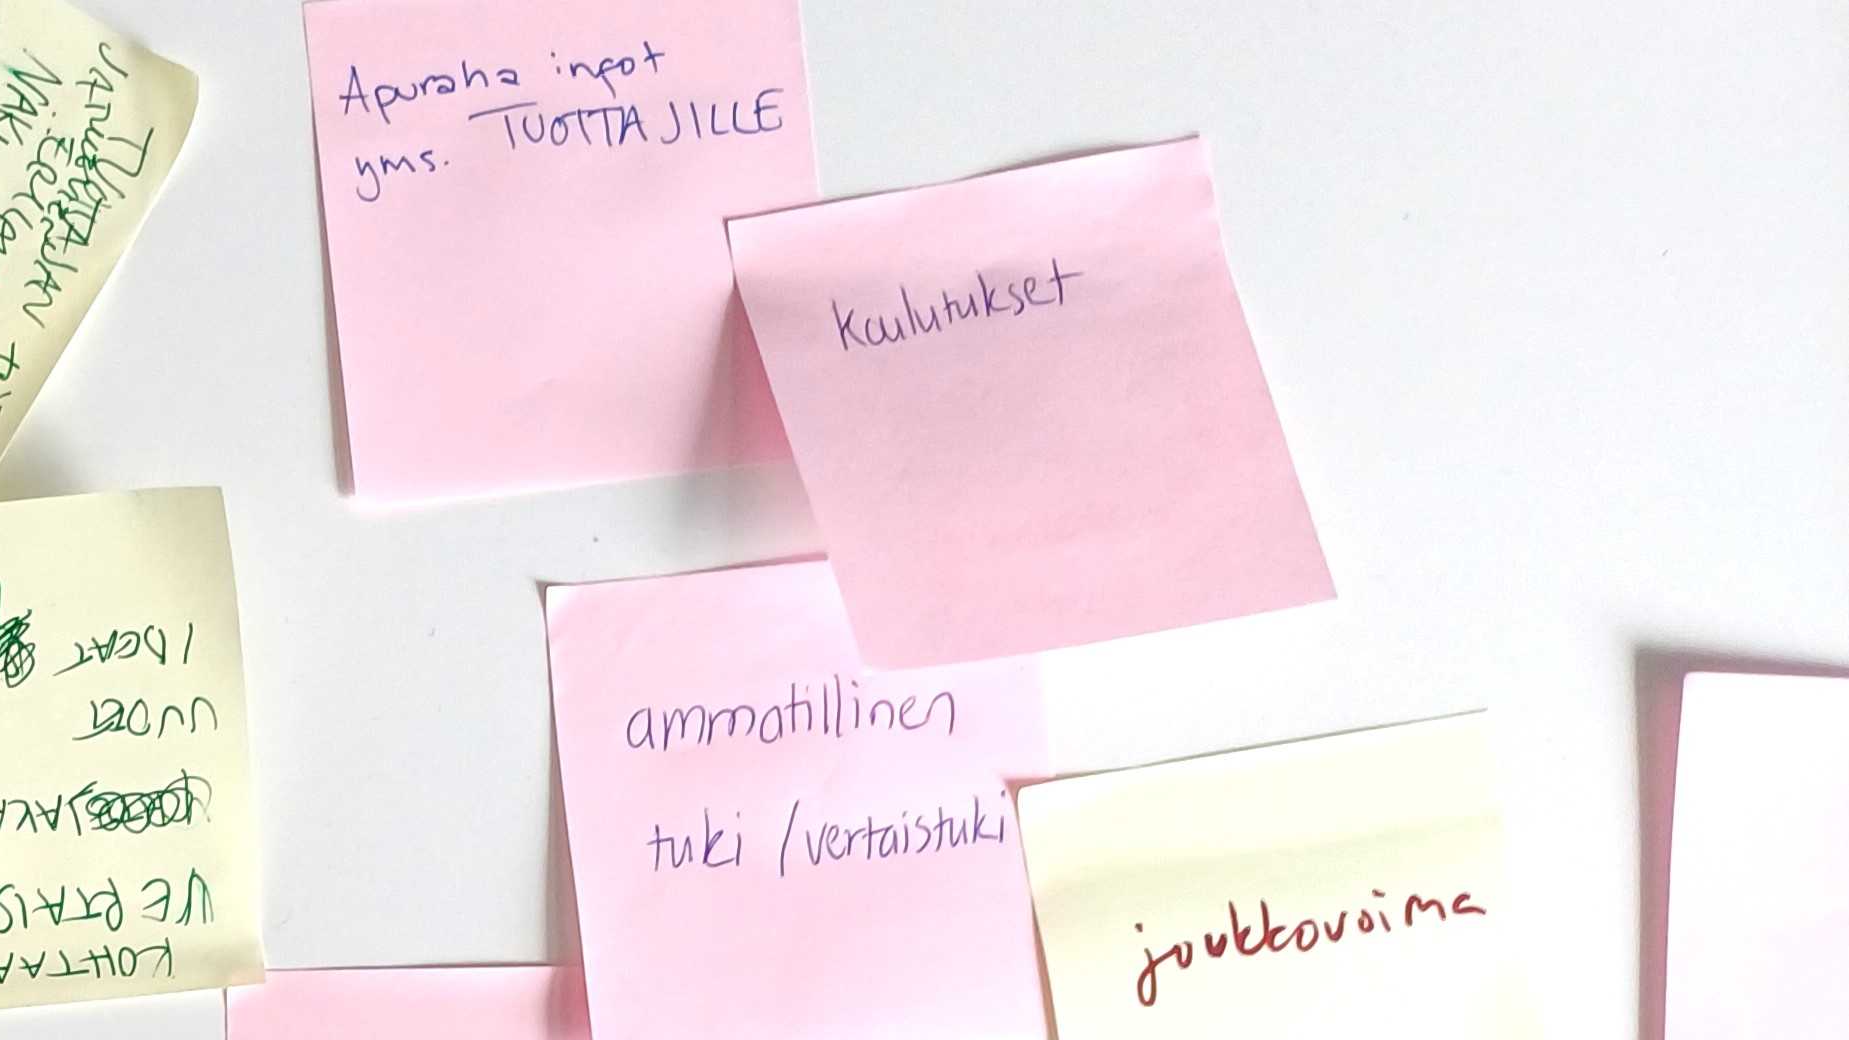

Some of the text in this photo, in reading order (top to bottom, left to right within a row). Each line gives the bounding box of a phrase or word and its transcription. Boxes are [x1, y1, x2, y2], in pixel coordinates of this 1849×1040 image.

[626, 673, 956, 752] ammatillinen
[646, 808, 743, 871] tuki
[1135, 889, 1487, 1008] joukkovoima
